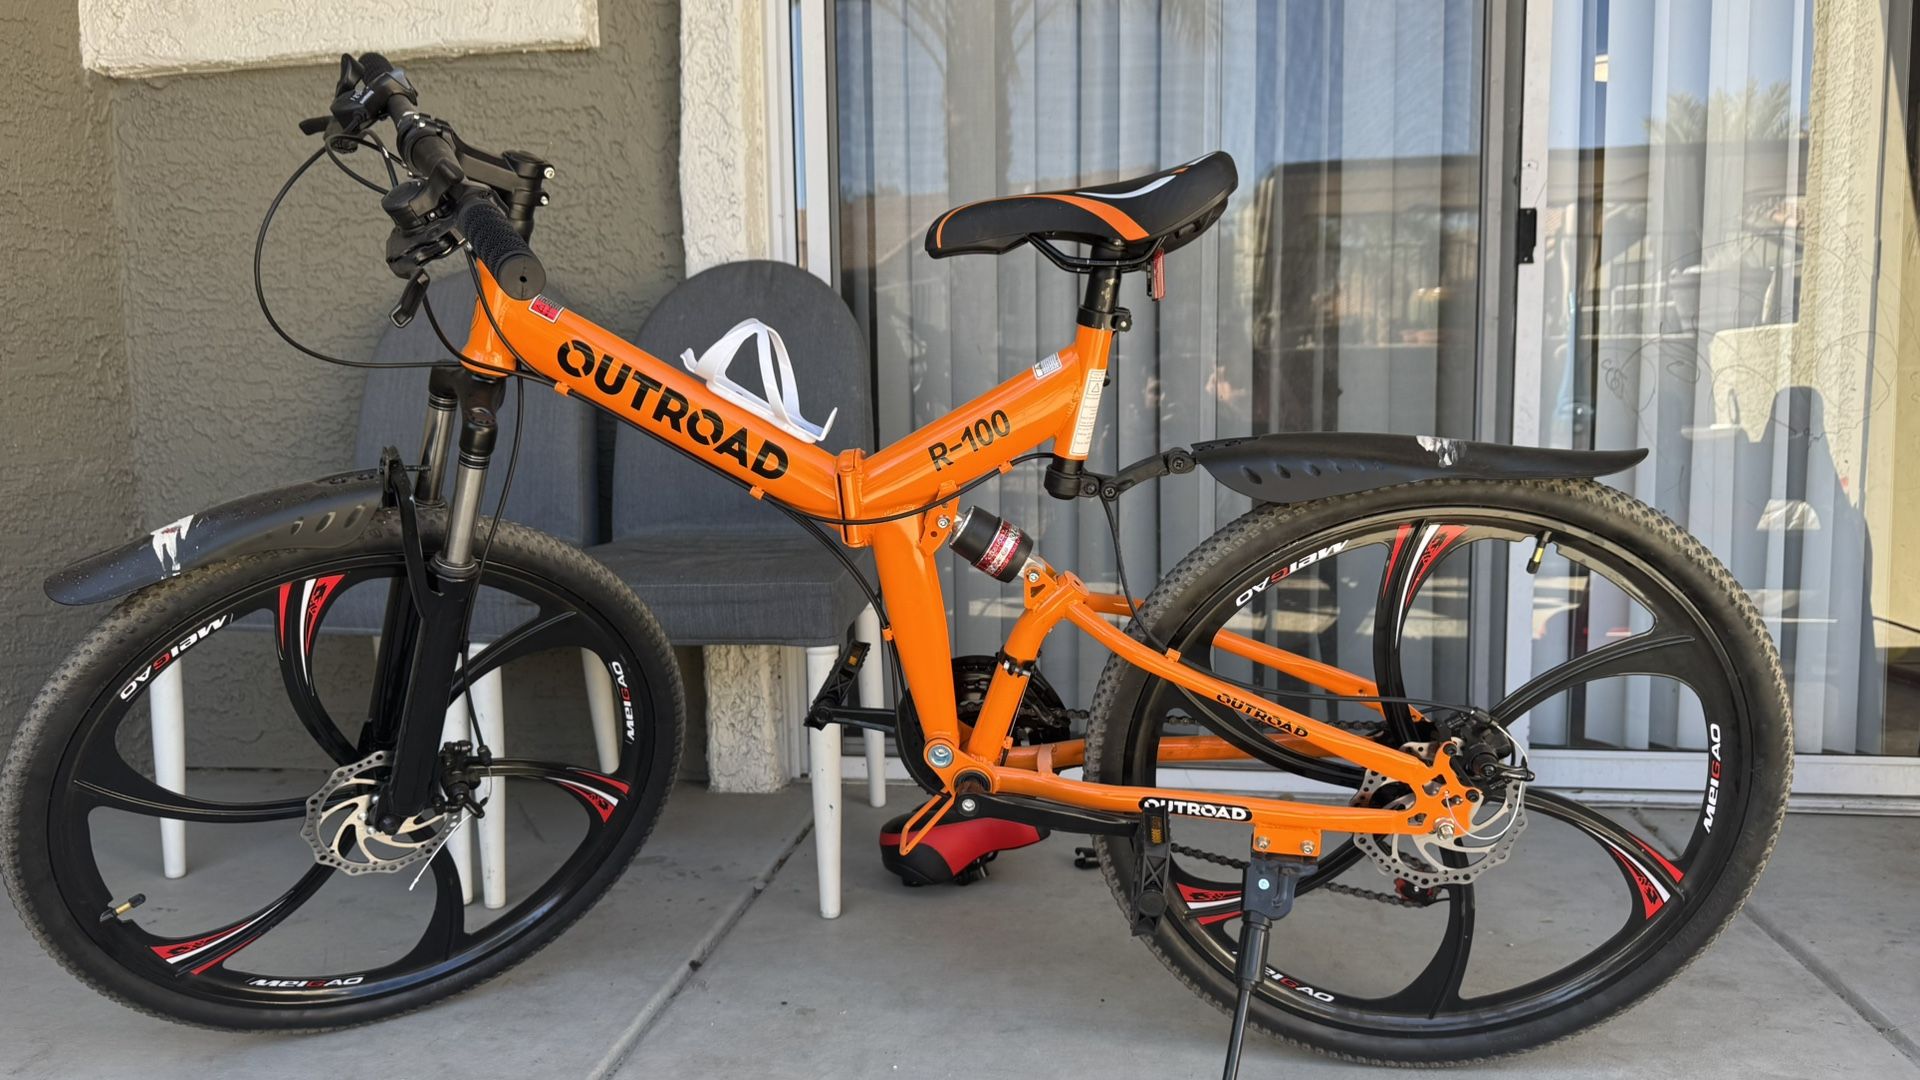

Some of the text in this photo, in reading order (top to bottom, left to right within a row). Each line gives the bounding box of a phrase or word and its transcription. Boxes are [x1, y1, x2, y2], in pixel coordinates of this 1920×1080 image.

[557, 339, 789, 480] OUTROAD
[928, 409, 1011, 472] R-100
[1216, 693, 1309, 737] OUTROAD
